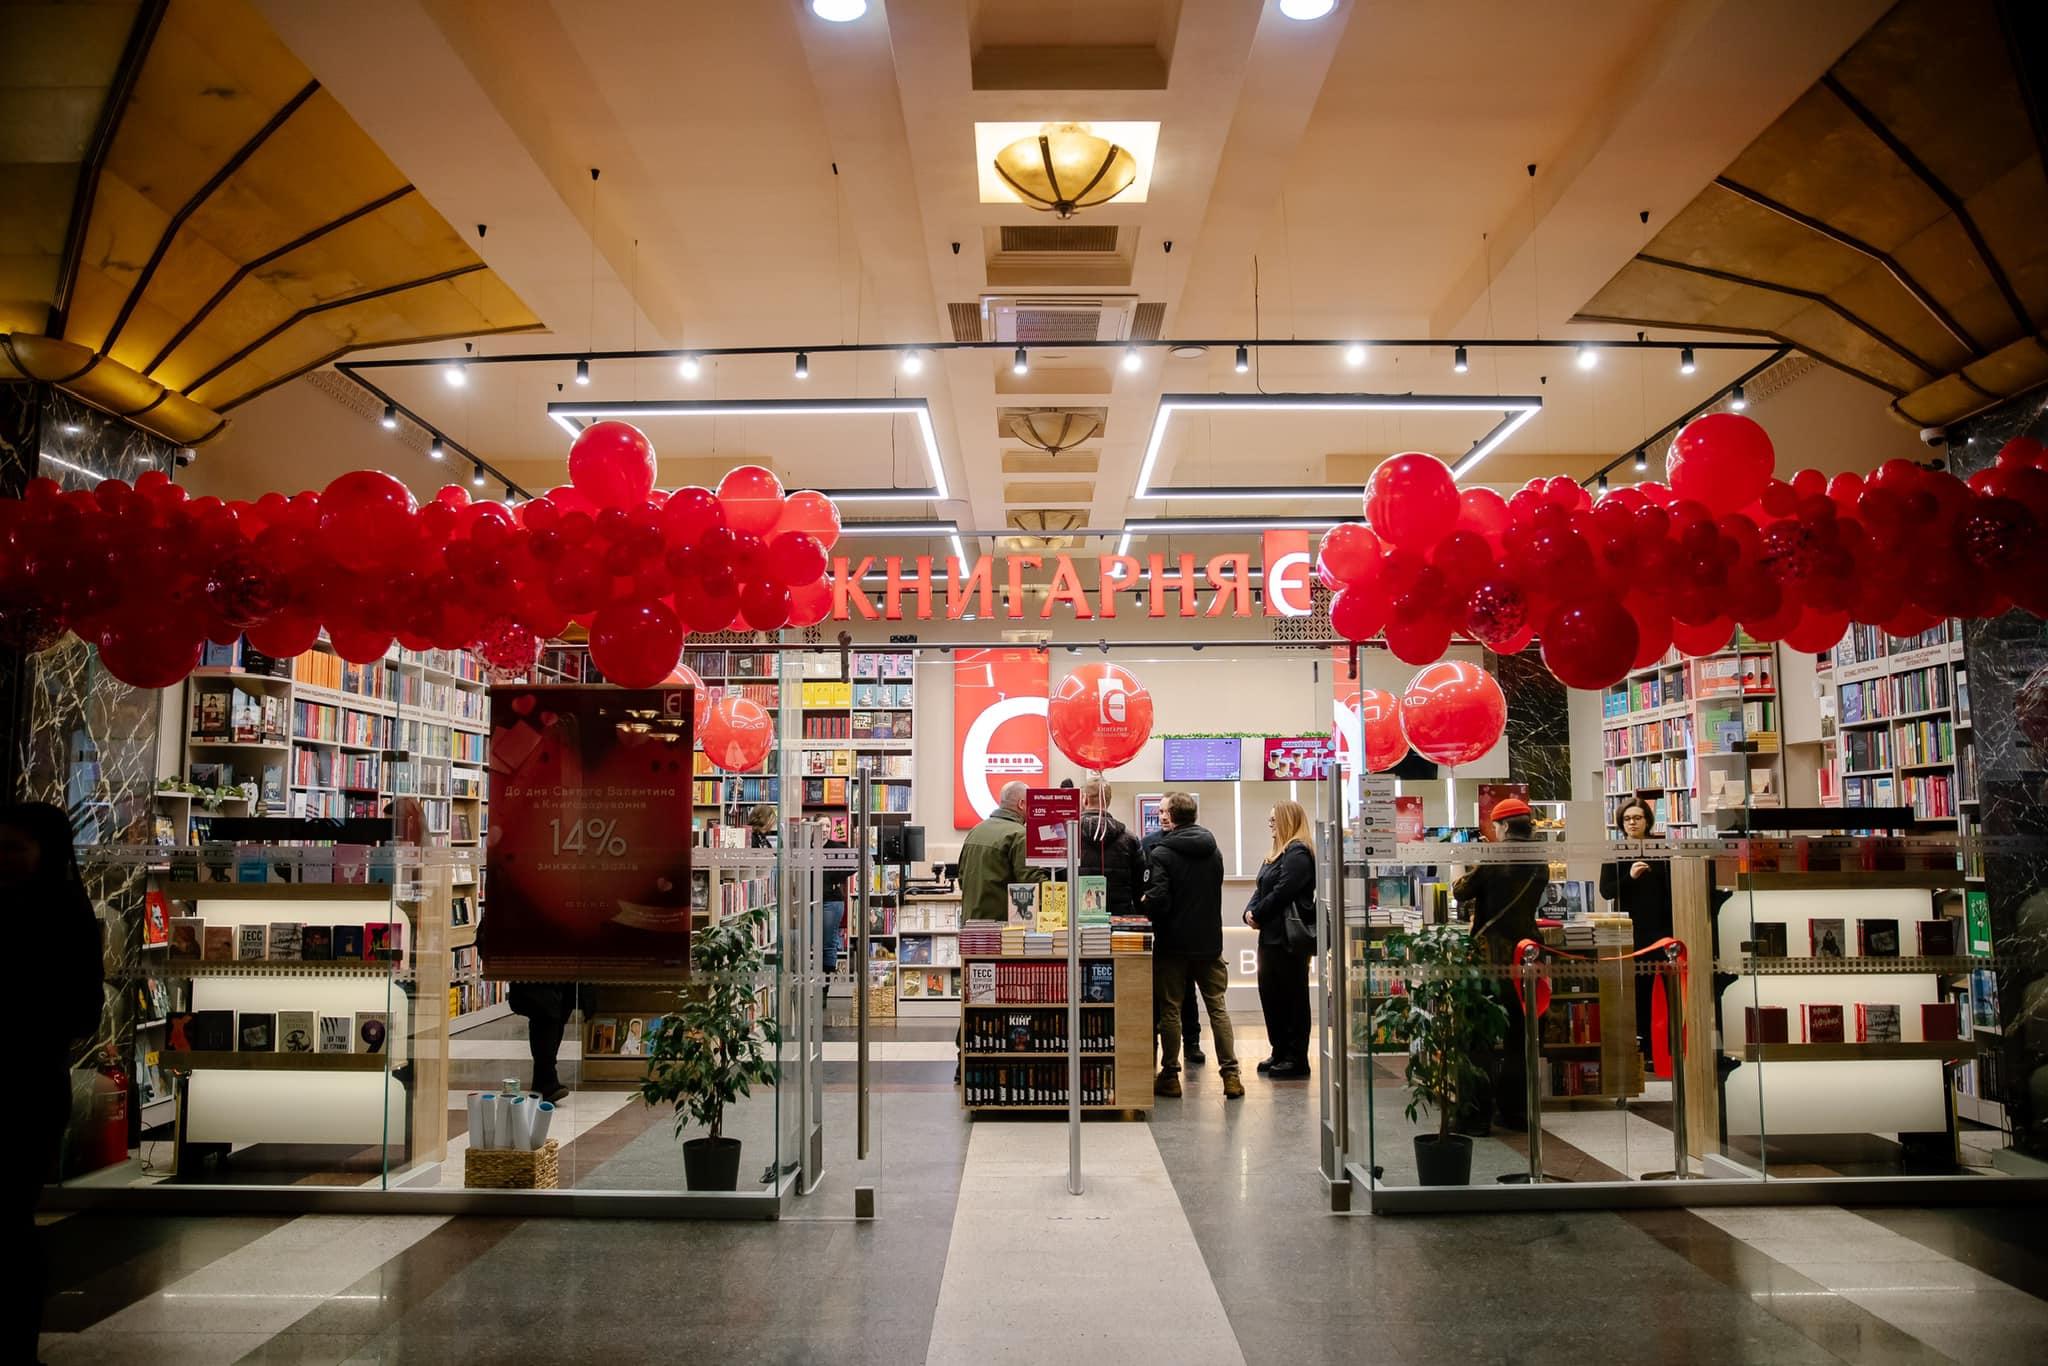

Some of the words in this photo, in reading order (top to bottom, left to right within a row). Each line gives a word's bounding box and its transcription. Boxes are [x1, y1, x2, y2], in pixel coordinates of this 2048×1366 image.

[832, 554, 1252, 620] КНИГАРНЯ
[1268, 552, 1312, 617] Є
[504, 785, 521, 799] До
[526, 788, 548, 798] дня
[607, 785, 676, 798] Валентина
[549, 817, 628, 858] 14%
[973, 968, 992, 978] ТЕСС
[1091, 966, 1113, 977] ТЕСС
